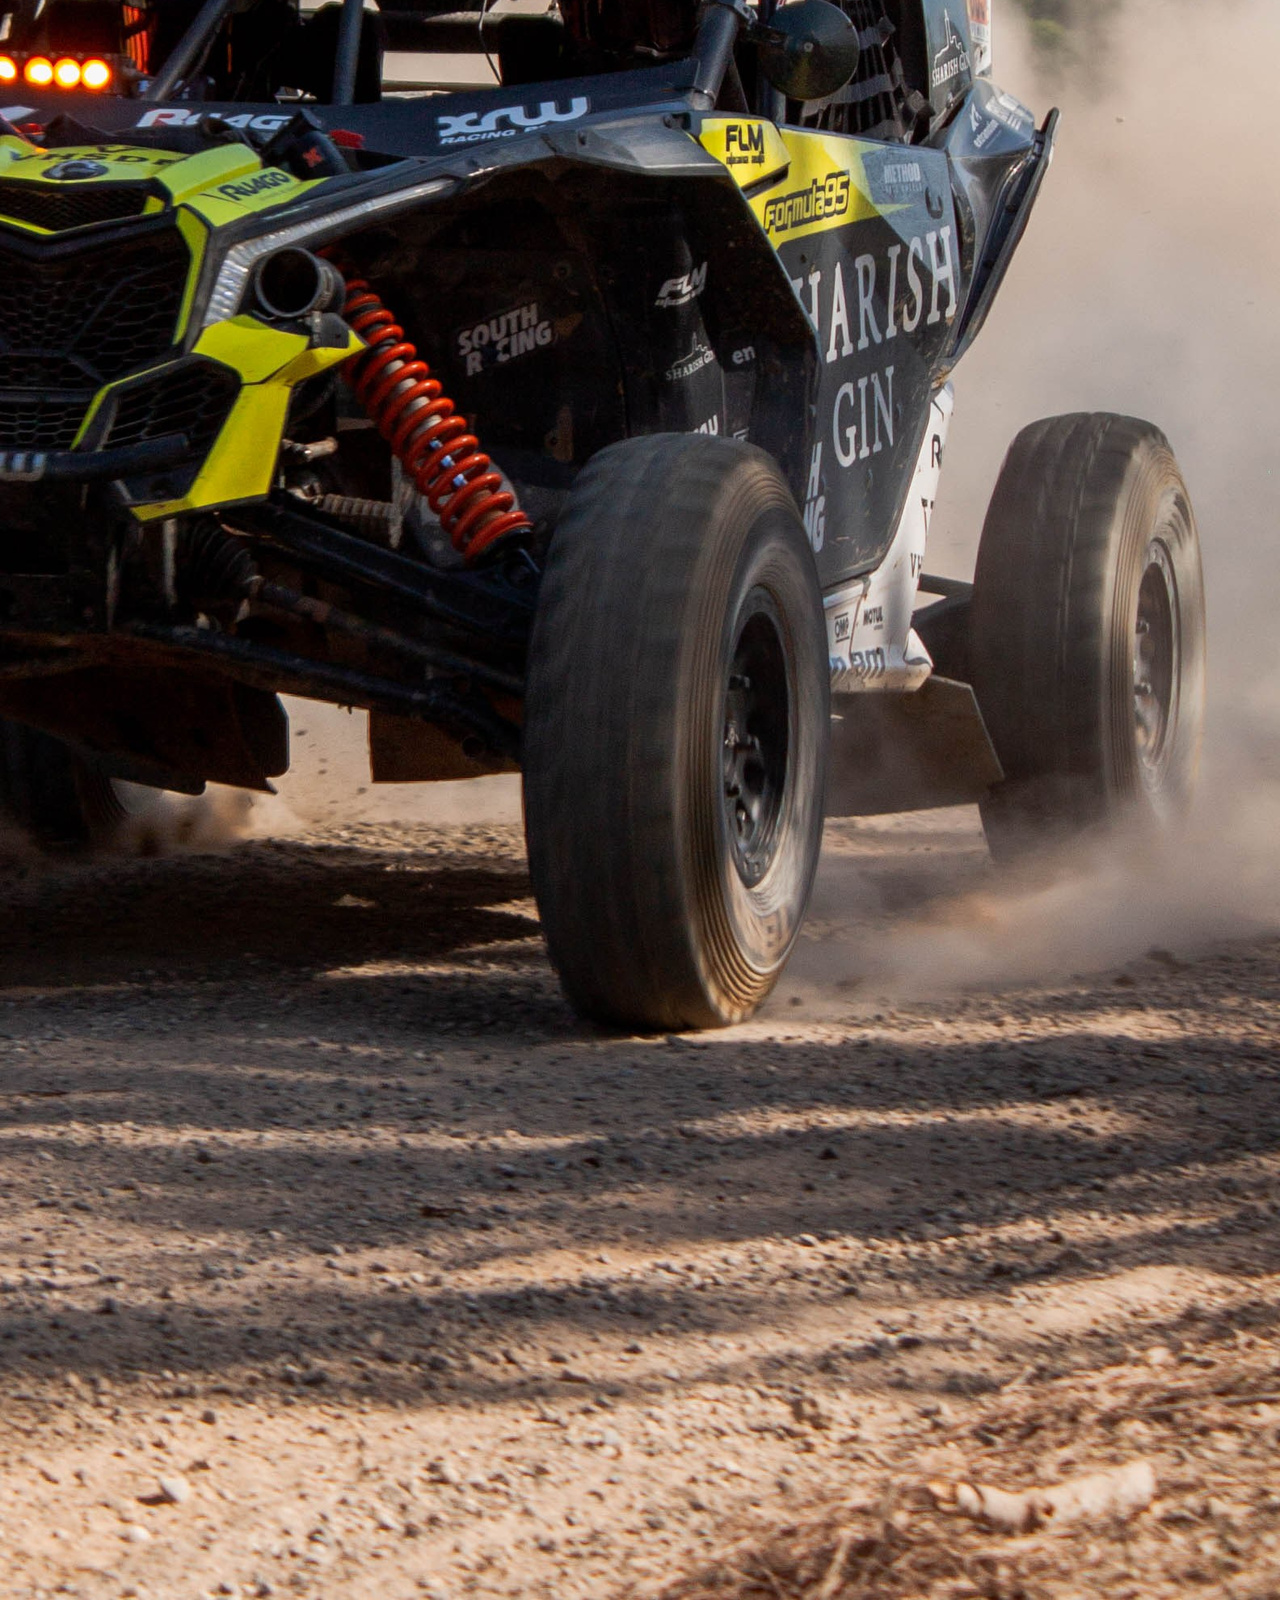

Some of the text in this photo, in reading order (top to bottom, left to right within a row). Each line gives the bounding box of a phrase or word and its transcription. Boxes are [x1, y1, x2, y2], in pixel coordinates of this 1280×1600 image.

[932, 59, 959, 88] SHARISH
[439, 129, 517, 145] RACING
[725, 124, 765, 154] FLM
[883, 162, 921, 185] METHOD
[763, 169, 850, 234] Formula95
[656, 261, 708, 298] FLM
[457, 303, 540, 356] SOUTH
[665, 357, 706, 381] SHARISH
[832, 365, 894, 468] GIN
[863, 606, 883, 626] MOTUL
